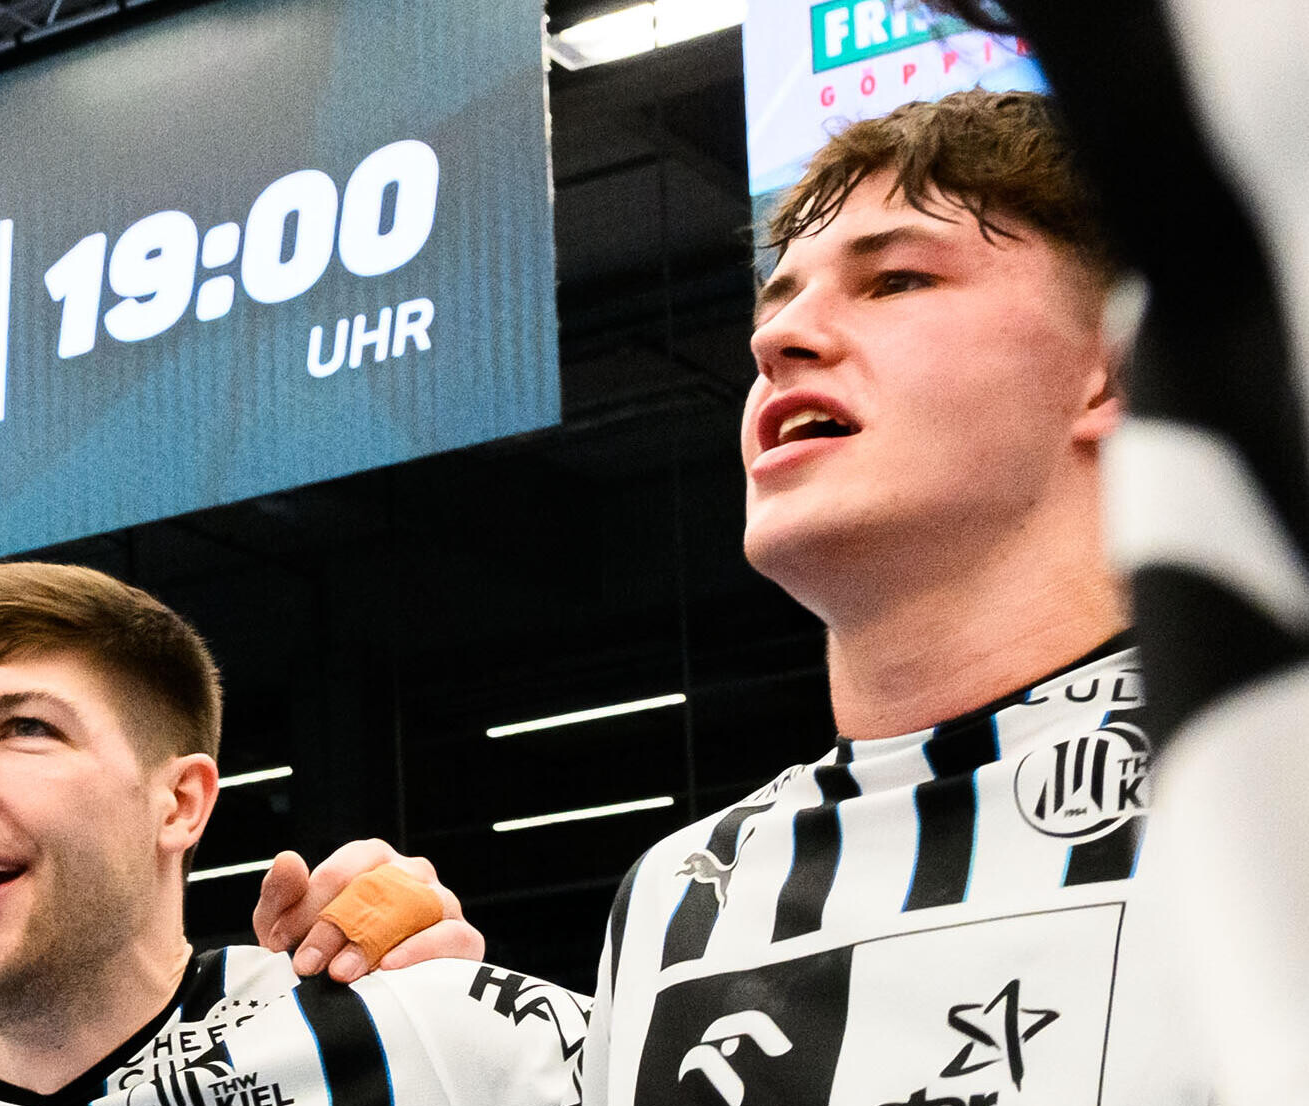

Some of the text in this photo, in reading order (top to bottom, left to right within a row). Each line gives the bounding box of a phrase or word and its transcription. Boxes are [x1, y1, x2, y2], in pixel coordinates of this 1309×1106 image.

[45, 139, 439, 359] 19:00
[307, 297, 434, 378] UHR
[208, 1072, 259, 1097] THW
